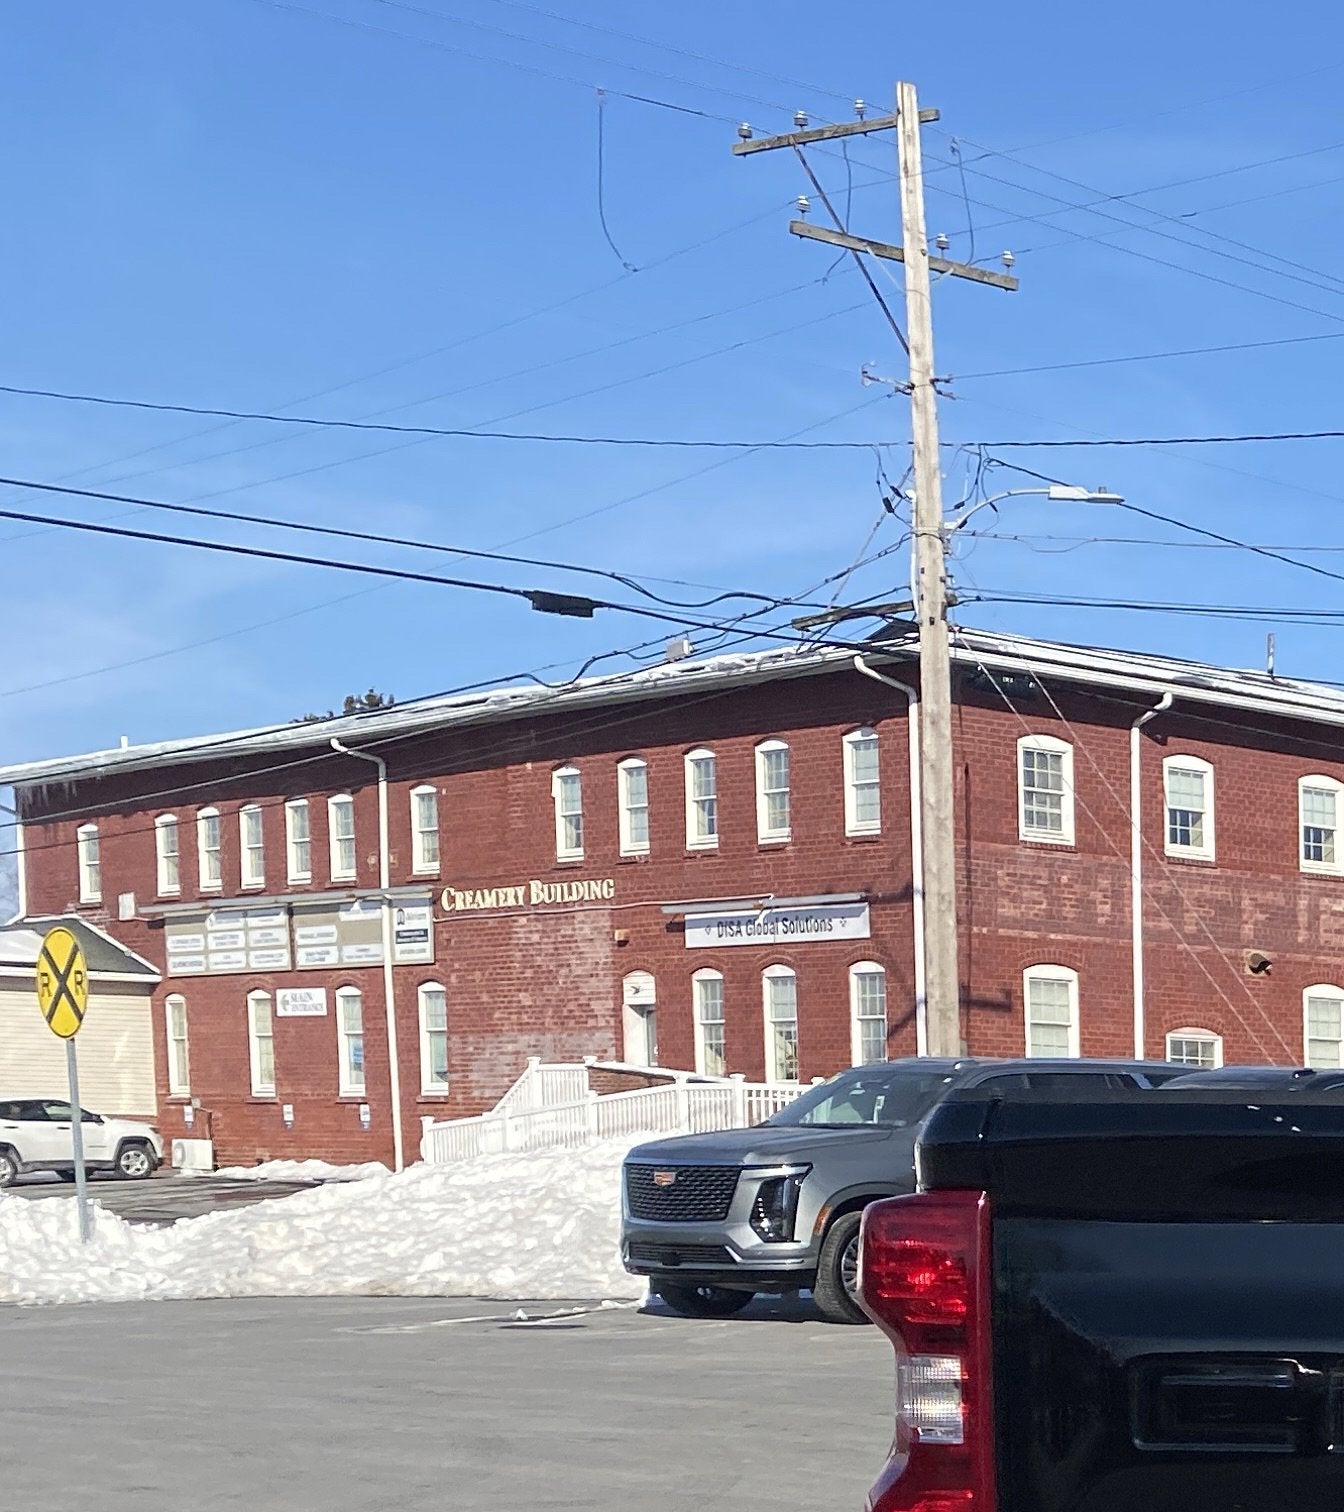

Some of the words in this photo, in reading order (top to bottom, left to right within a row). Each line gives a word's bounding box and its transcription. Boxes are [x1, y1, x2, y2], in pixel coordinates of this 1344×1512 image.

[440, 885, 526, 912] CREAMERY
[529, 878, 615, 905] BUILDING
[716, 921, 743, 938] DISA
[782, 917, 833, 933] Solutions
